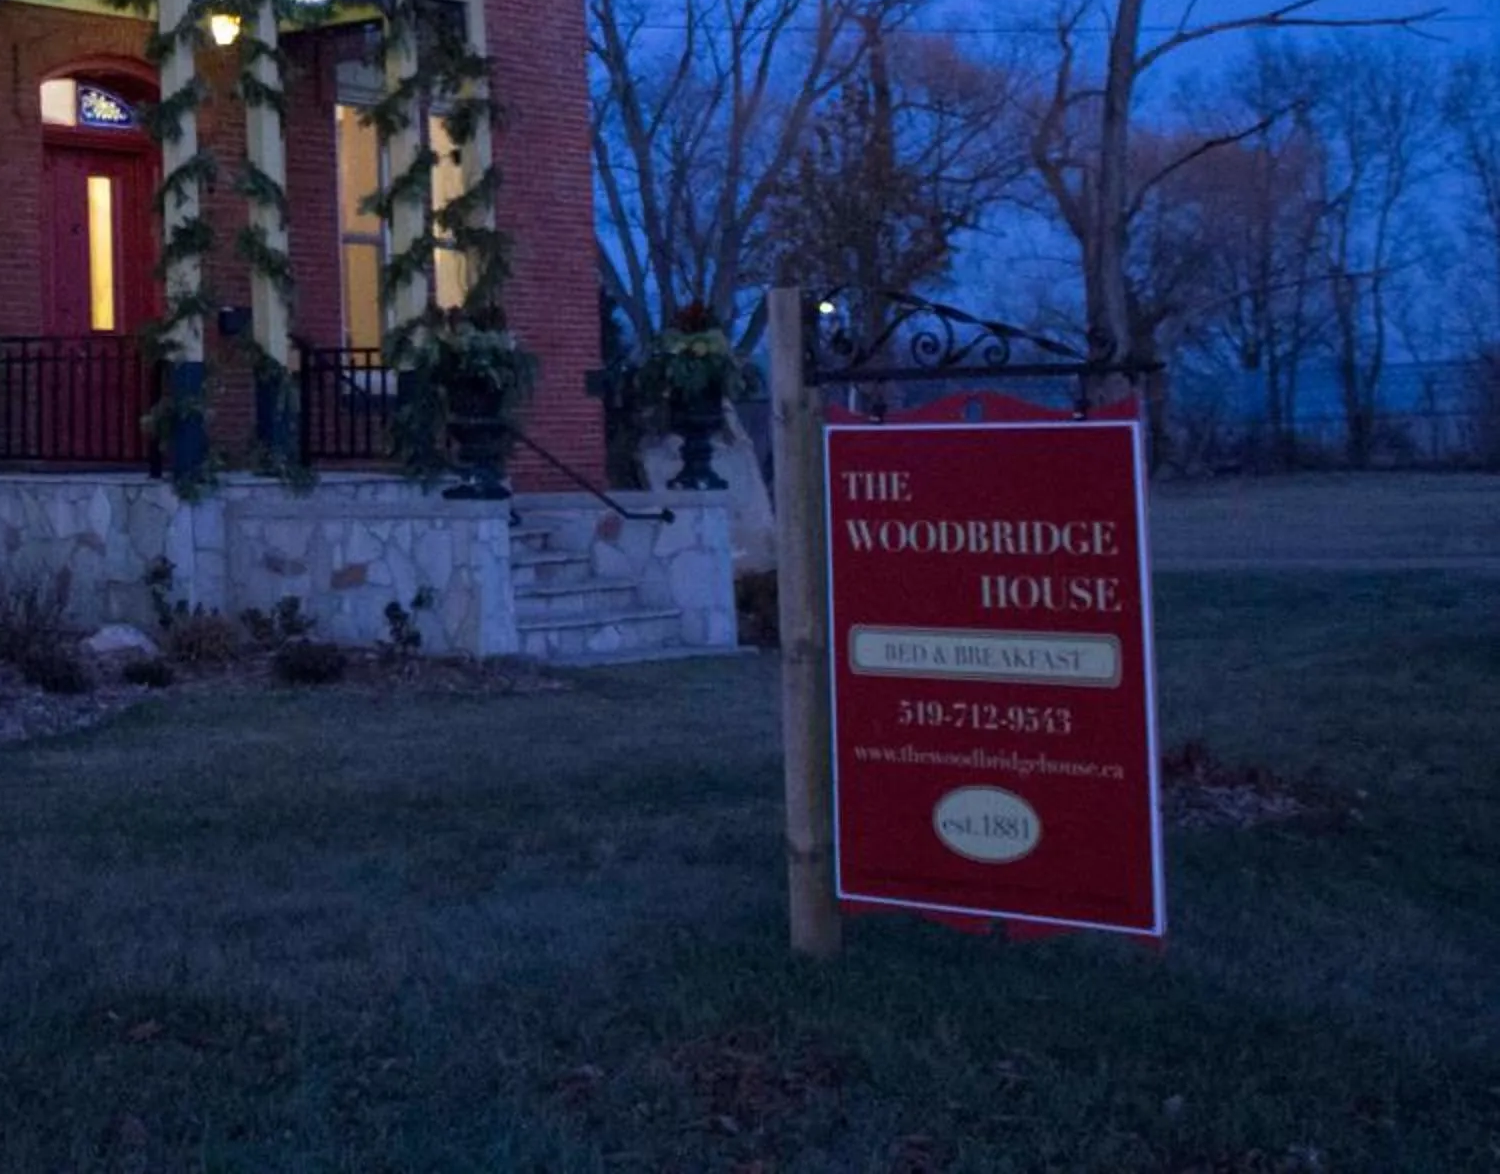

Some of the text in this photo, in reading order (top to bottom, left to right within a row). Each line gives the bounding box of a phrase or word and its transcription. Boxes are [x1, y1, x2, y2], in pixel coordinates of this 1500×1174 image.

[841, 470, 912, 502] THE
[845, 518, 1120, 556] WOODBRIDGE
[980, 574, 1123, 613] HOUSE
[884, 642, 1083, 672] BED & BREAKFAST
[897, 699, 1073, 735] 519-712-9543
[854, 744, 1125, 780] www.thewoodbridgehouse.ca
